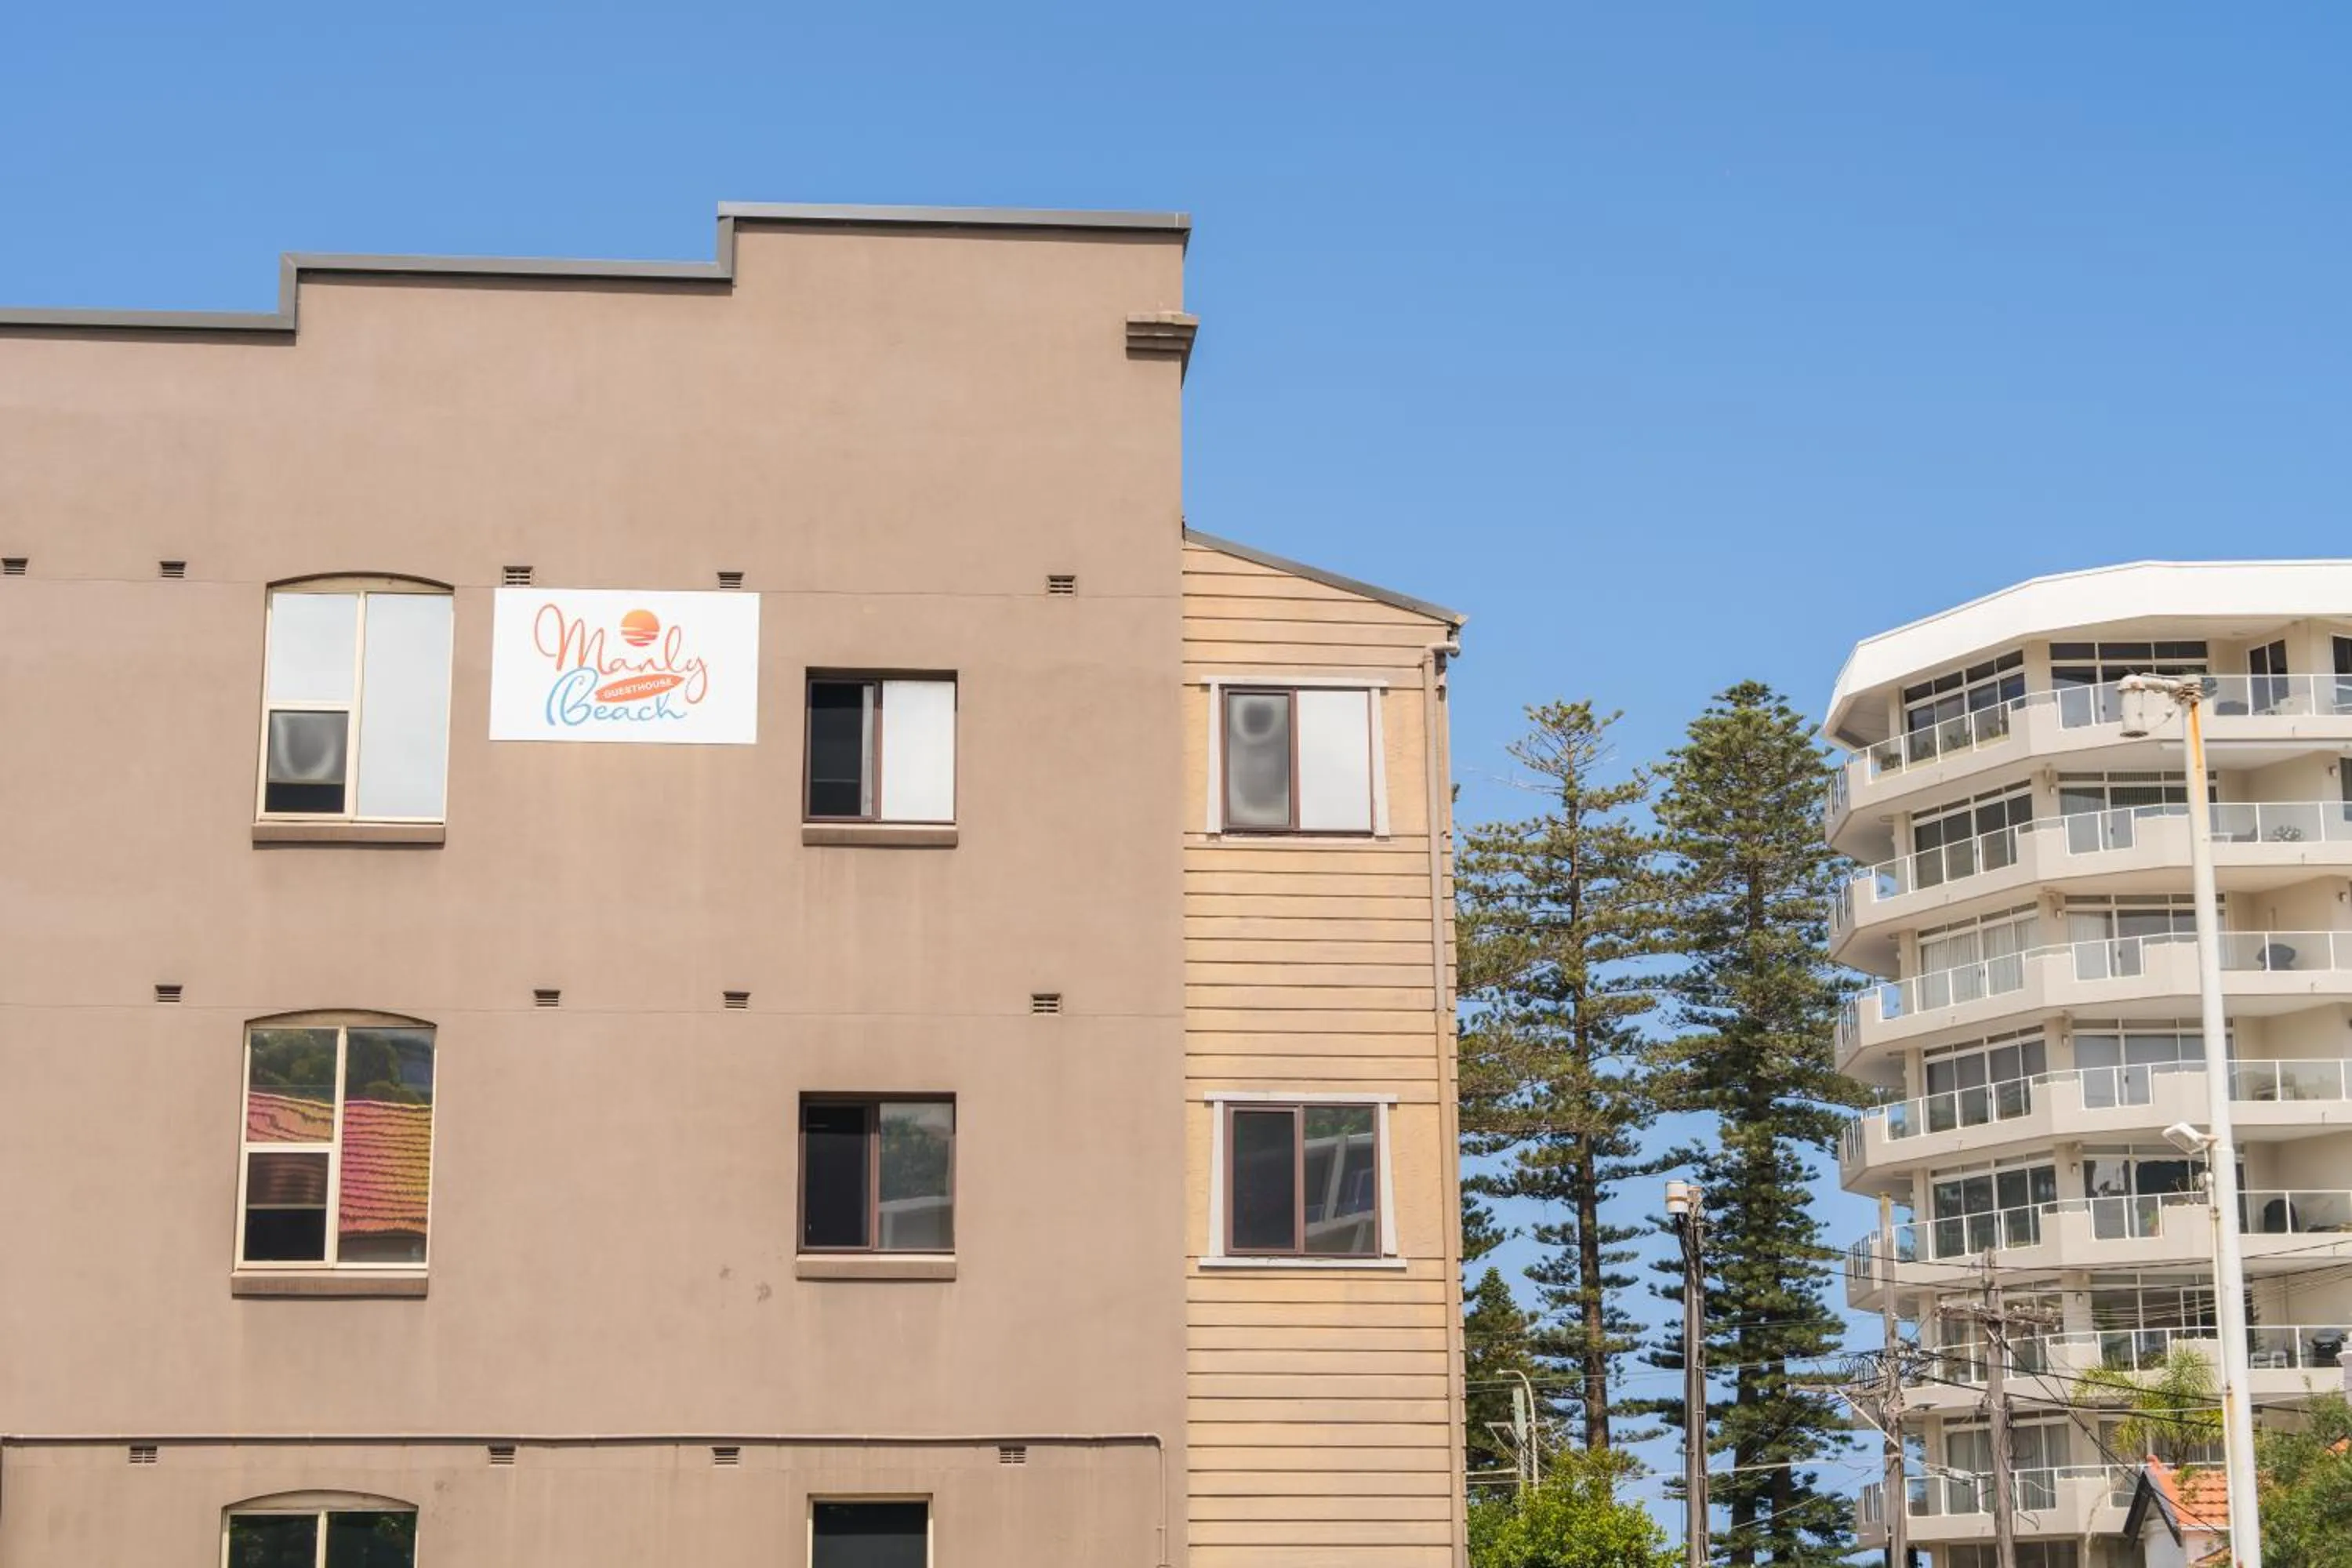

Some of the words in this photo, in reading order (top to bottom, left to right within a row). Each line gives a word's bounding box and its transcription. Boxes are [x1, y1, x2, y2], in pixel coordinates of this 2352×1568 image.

[534, 603, 708, 705] Manly
[546, 666, 688, 726] Beach
[603, 677, 673, 699] GUESTHOUSE
